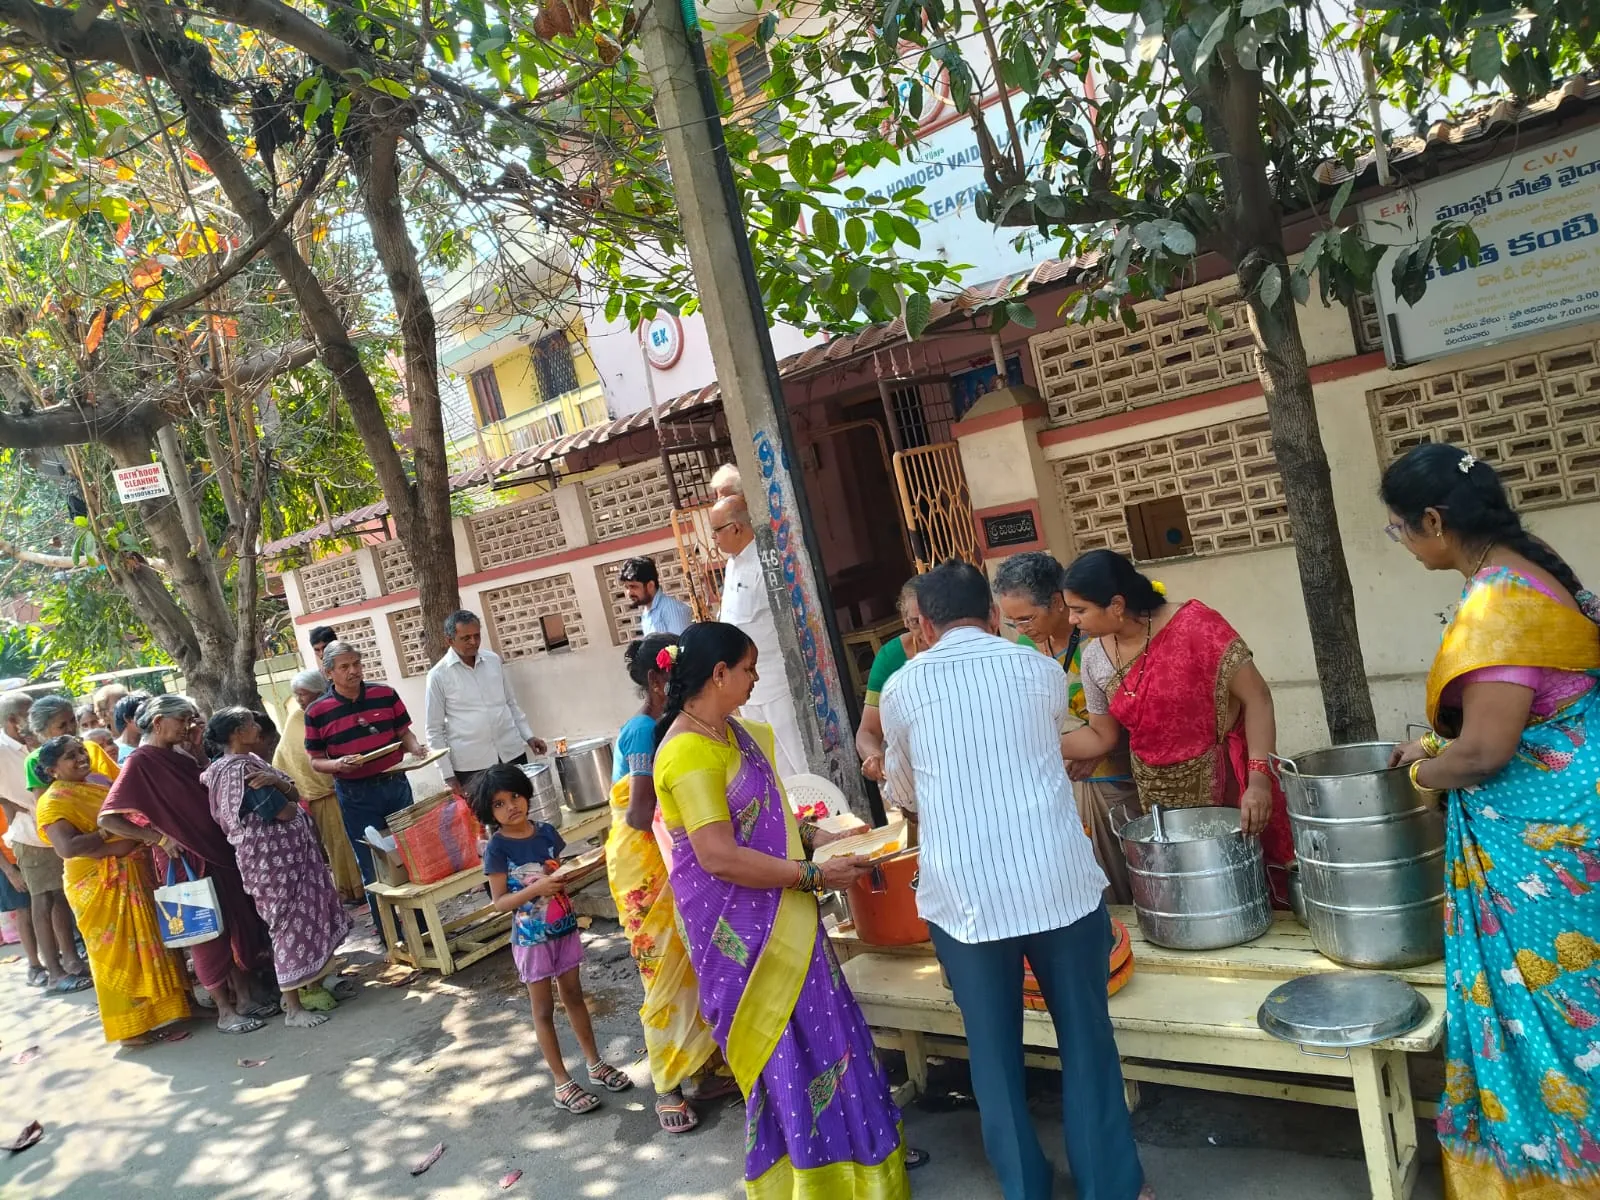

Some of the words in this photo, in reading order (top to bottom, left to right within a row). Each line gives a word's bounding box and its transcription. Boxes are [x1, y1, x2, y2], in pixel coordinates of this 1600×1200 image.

[1523, 146, 1578, 171] C.V.V
[886, 162, 944, 198] HOMOEO
[119, 472, 137, 480] BATH
[138, 468, 160, 477] ROOM
[124, 477, 159, 488] CLEANING
[761, 549, 779, 567] 46
[769, 572, 778, 587] A
